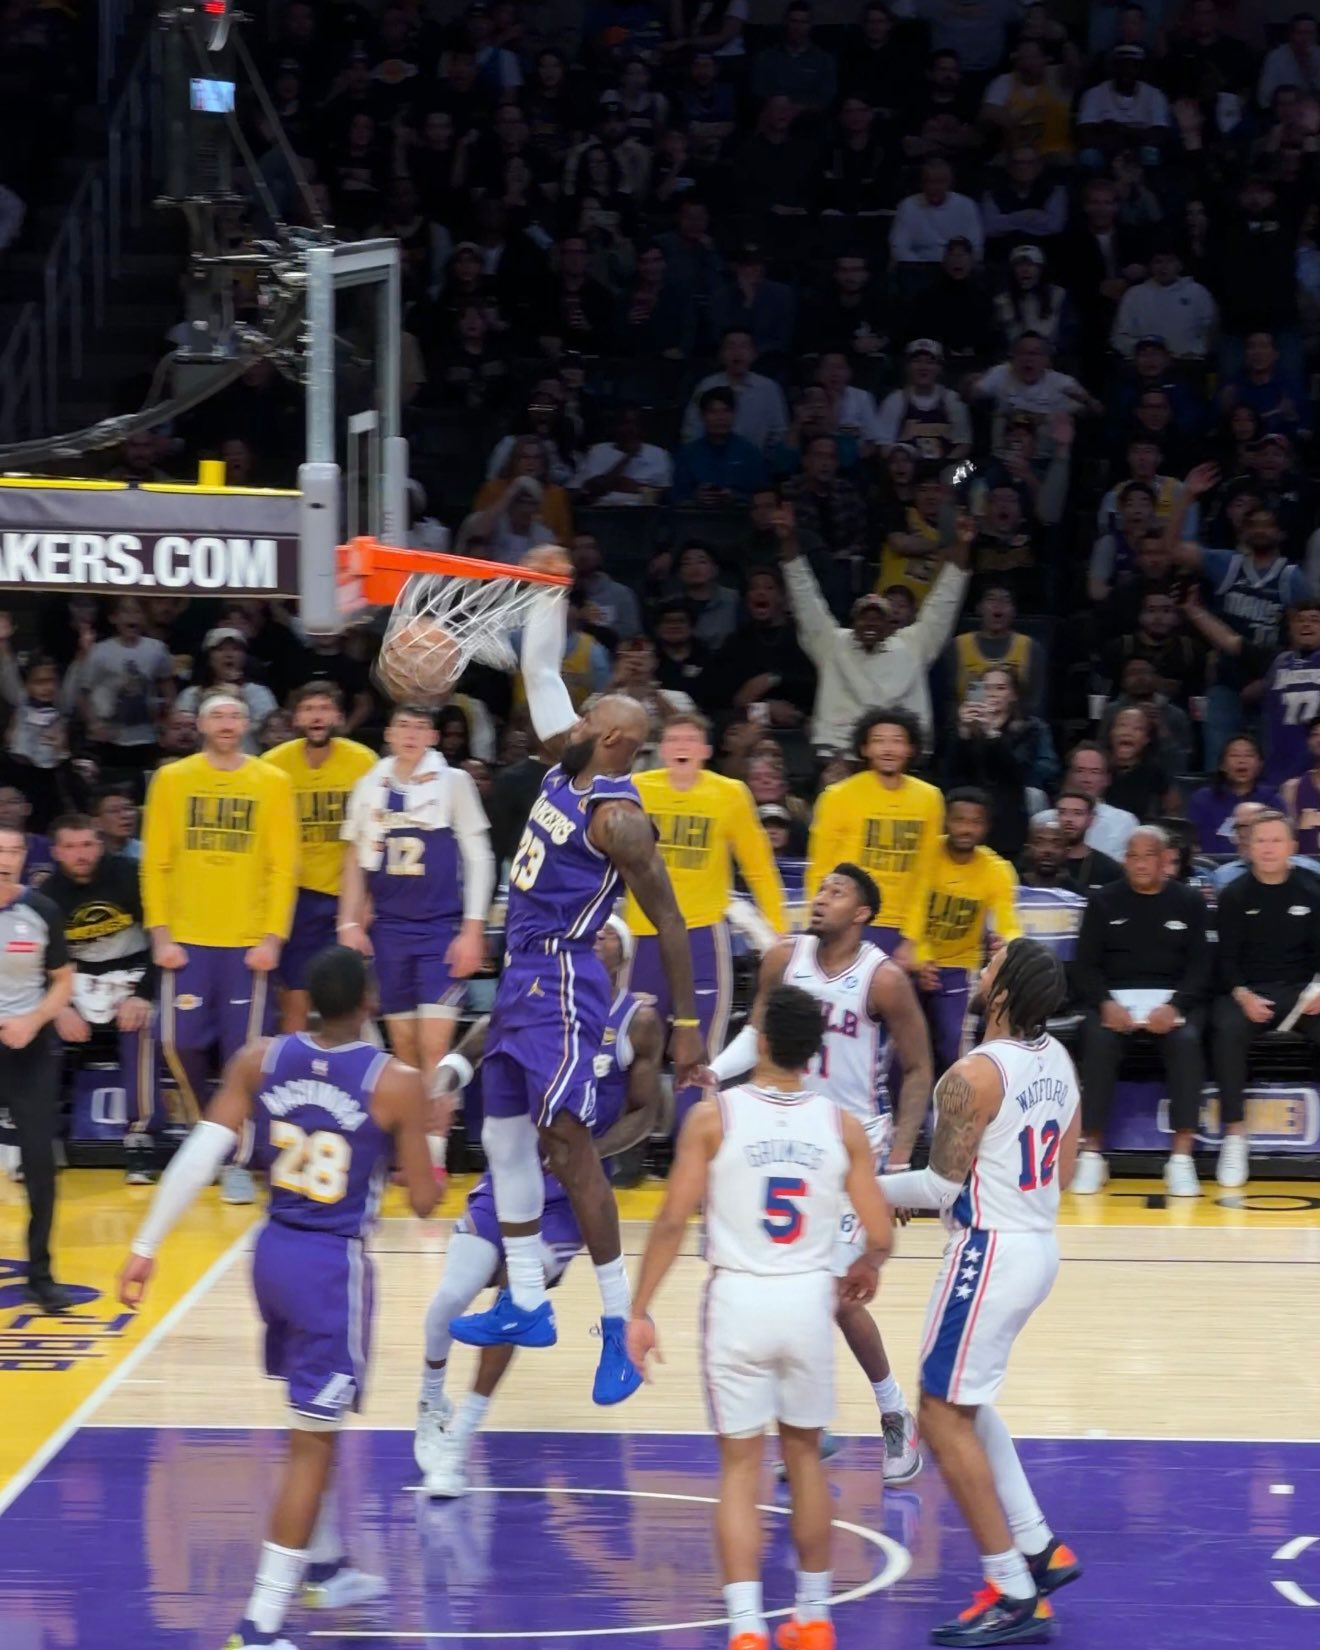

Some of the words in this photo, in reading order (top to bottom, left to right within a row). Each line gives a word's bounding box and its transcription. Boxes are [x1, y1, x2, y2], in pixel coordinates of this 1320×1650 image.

[269, 1119, 353, 1204] 28
[1018, 1118, 1061, 1192] 12
[758, 1176, 809, 1245] 5
